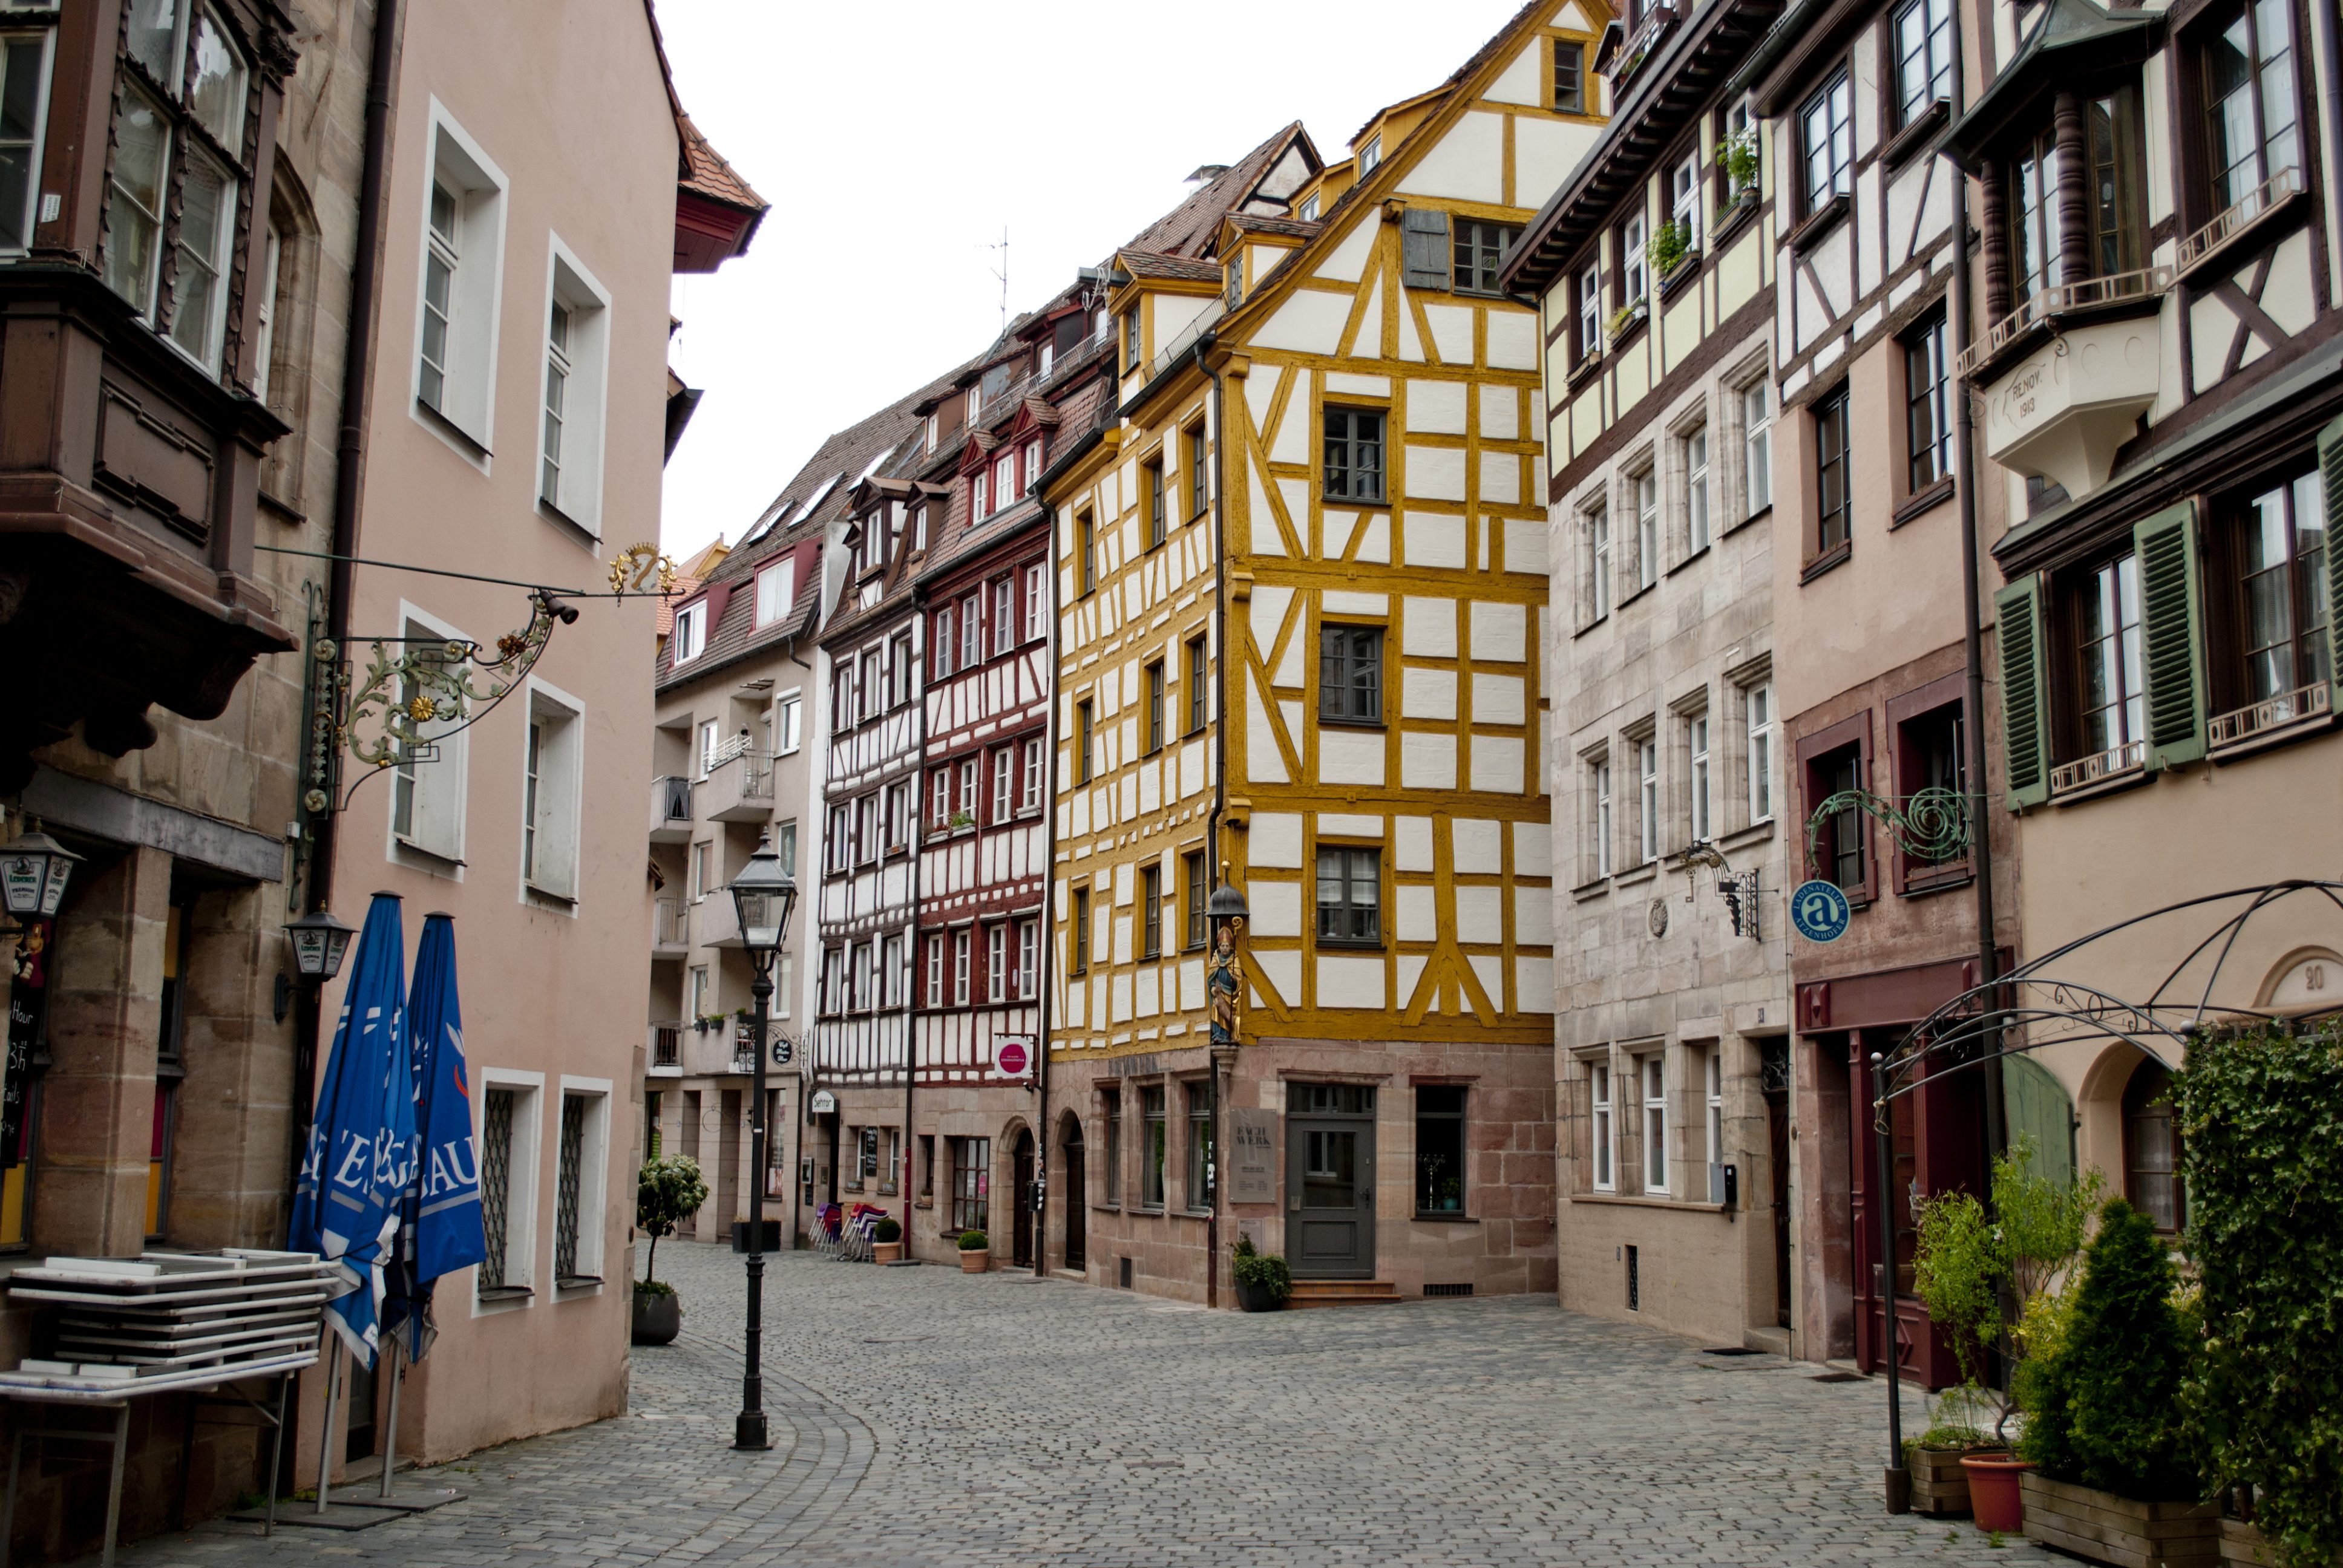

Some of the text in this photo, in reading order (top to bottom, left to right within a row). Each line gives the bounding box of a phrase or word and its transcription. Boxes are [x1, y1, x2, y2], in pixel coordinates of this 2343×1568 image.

[2013, 370, 2042, 402] RENOV.
[2020, 397, 2036, 419] 1913
[1794, 884, 1846, 911] LADENATELIER
[1807, 895, 1833, 927] a
[1795, 918, 1846, 939] ATZENHOFER
[2305, 965, 2324, 990] 20
[1237, 1136, 1271, 1145] WERK
